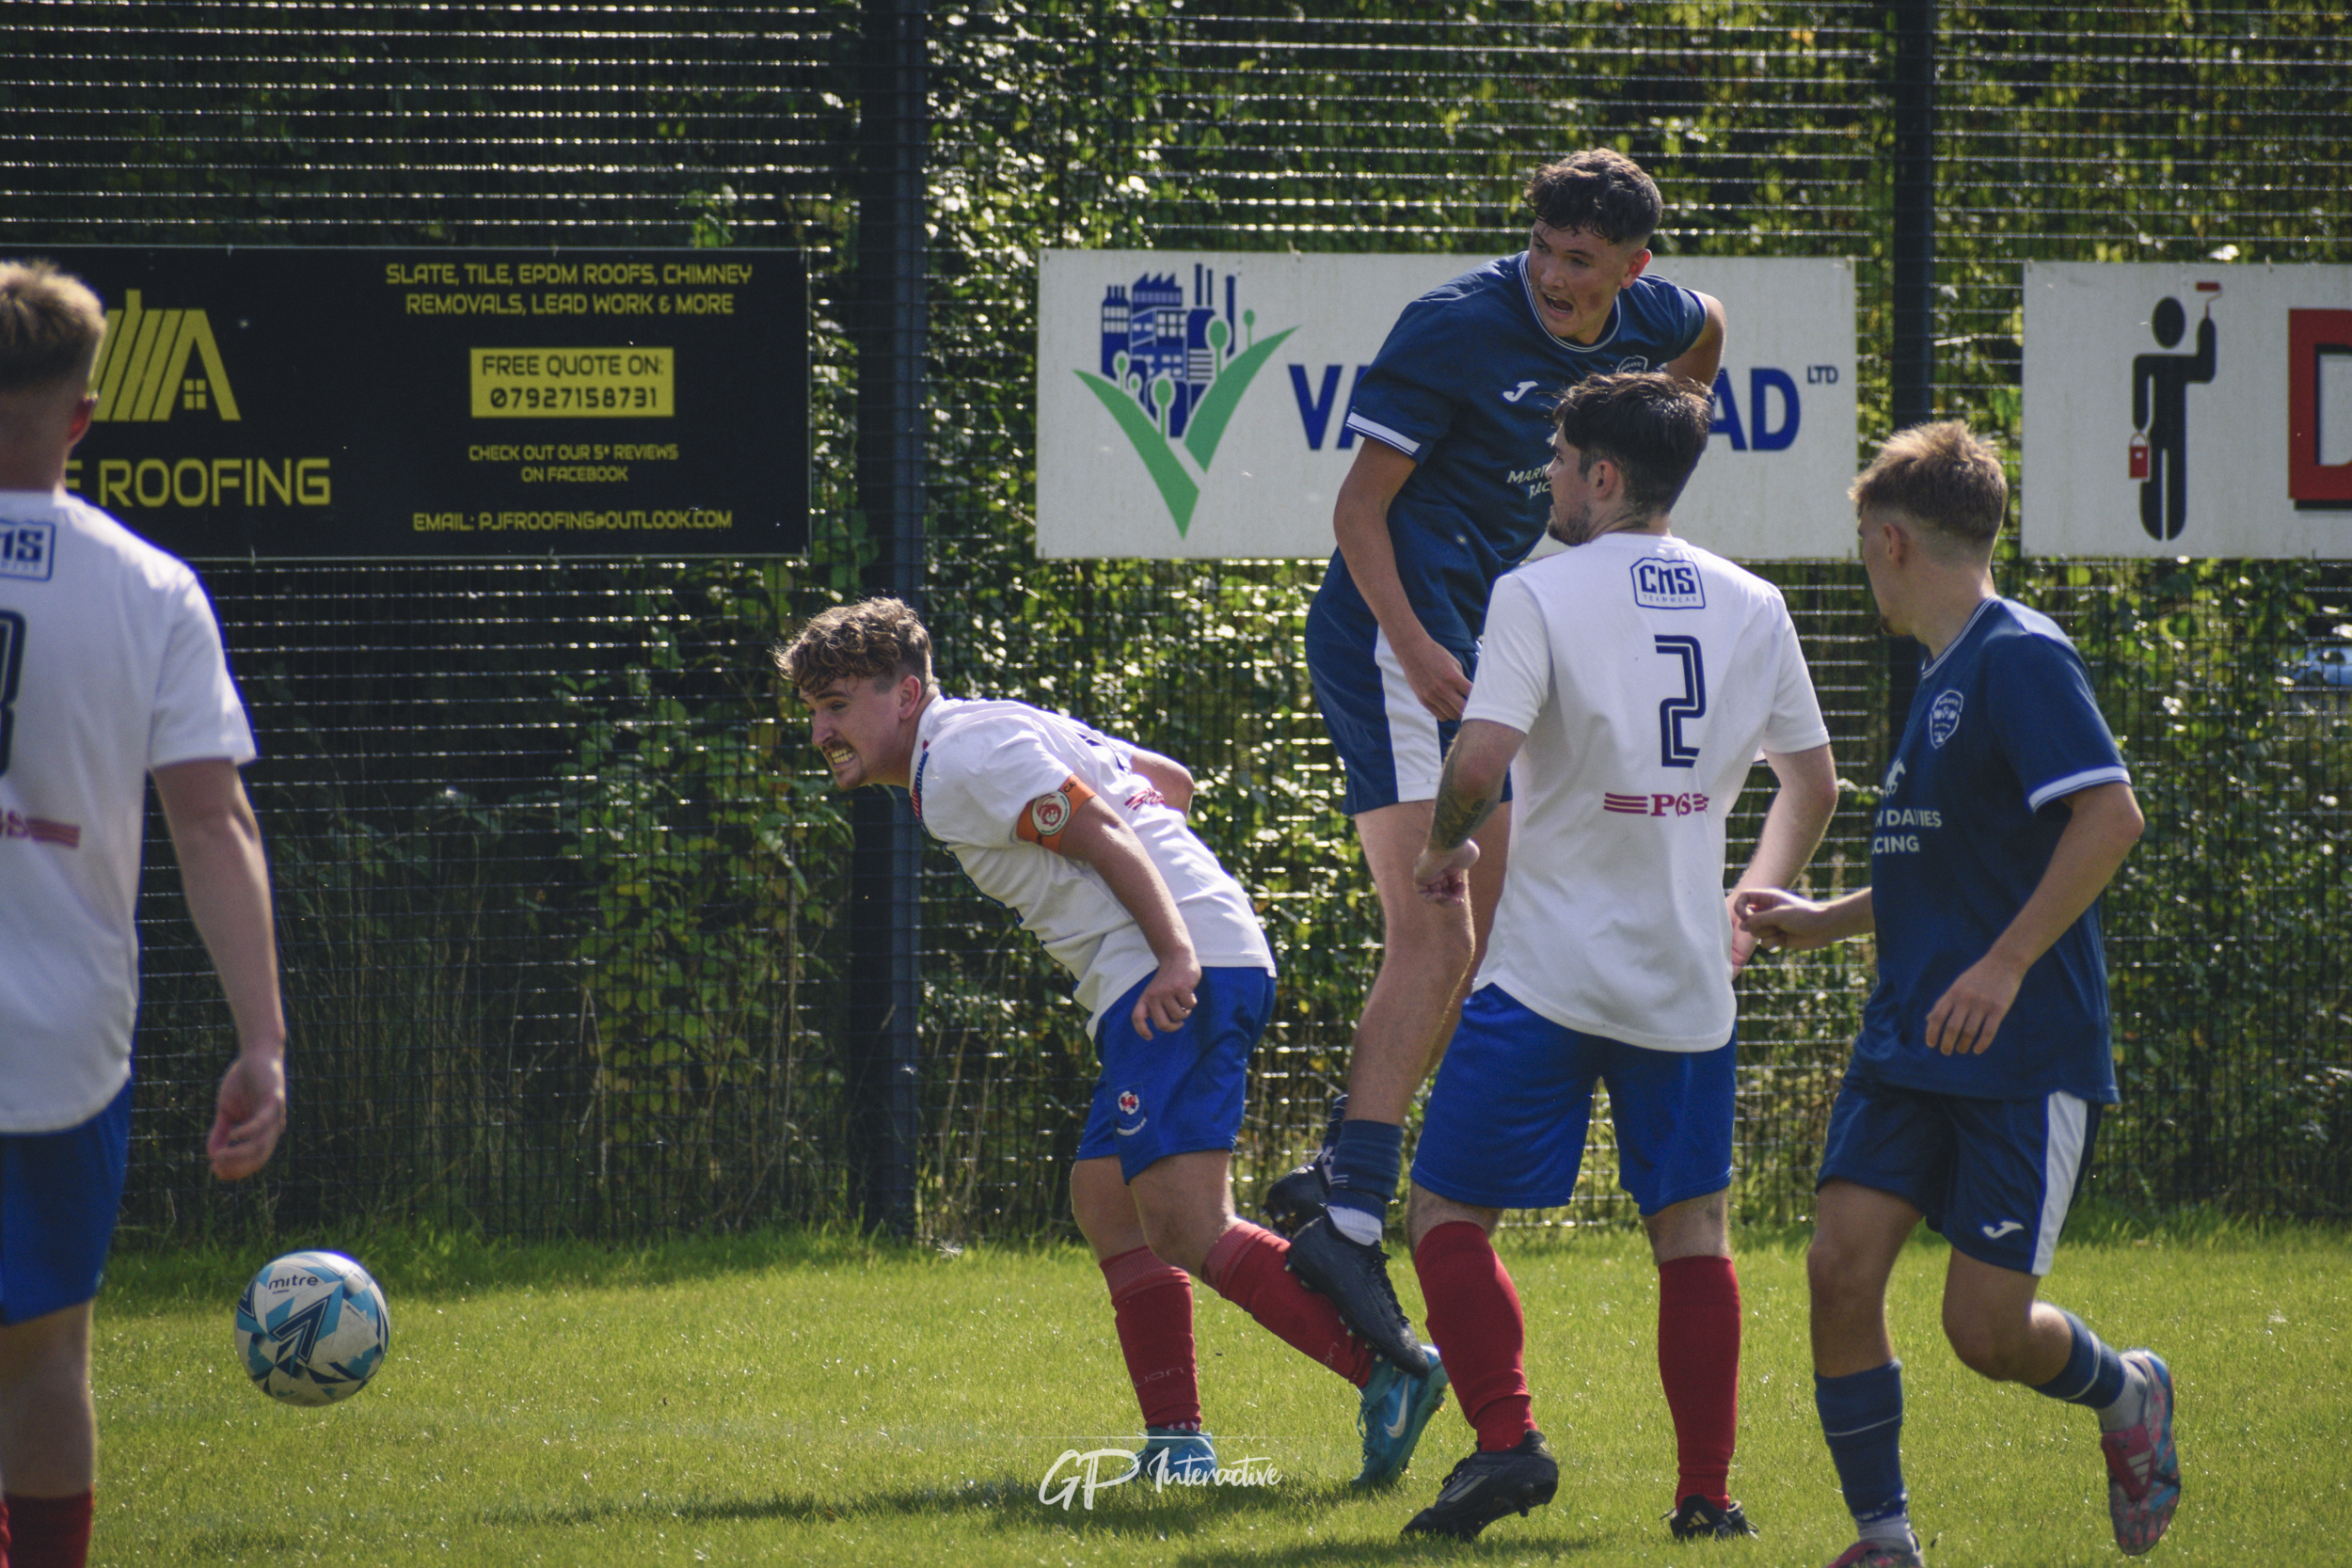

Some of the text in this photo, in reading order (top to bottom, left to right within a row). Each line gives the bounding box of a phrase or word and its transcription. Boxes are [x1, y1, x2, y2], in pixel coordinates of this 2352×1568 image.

[386, 263, 753, 286] SLATE, TILE, EPDM ROOFS, CHIMNEY
[405, 293, 735, 316] REMOVALS, LEAD WORK & MORE
[483, 355, 664, 378] FREE QUOTE ON:
[1807, 365, 1839, 384] LTD
[490, 387, 657, 408] 07927158731
[469, 445, 519, 461] CHECK
[522, 445, 555, 461] OUT
[557, 444, 591, 461] OUR
[612, 444, 679, 460] REVIEWS
[99, 457, 330, 507] ROOFING
[520, 465, 628, 482] ON FACEBOOK
[413, 510, 732, 531] EMAIL: PJFROOFING@OUTLOOK.COM
[1639, 565, 1696, 594] CMS
[1644, 594, 1697, 603] TEAMWEAR
[1654, 634, 1706, 768] 2
[1872, 834, 1920, 854] CING
[268, 1274, 319, 1290] mitre
